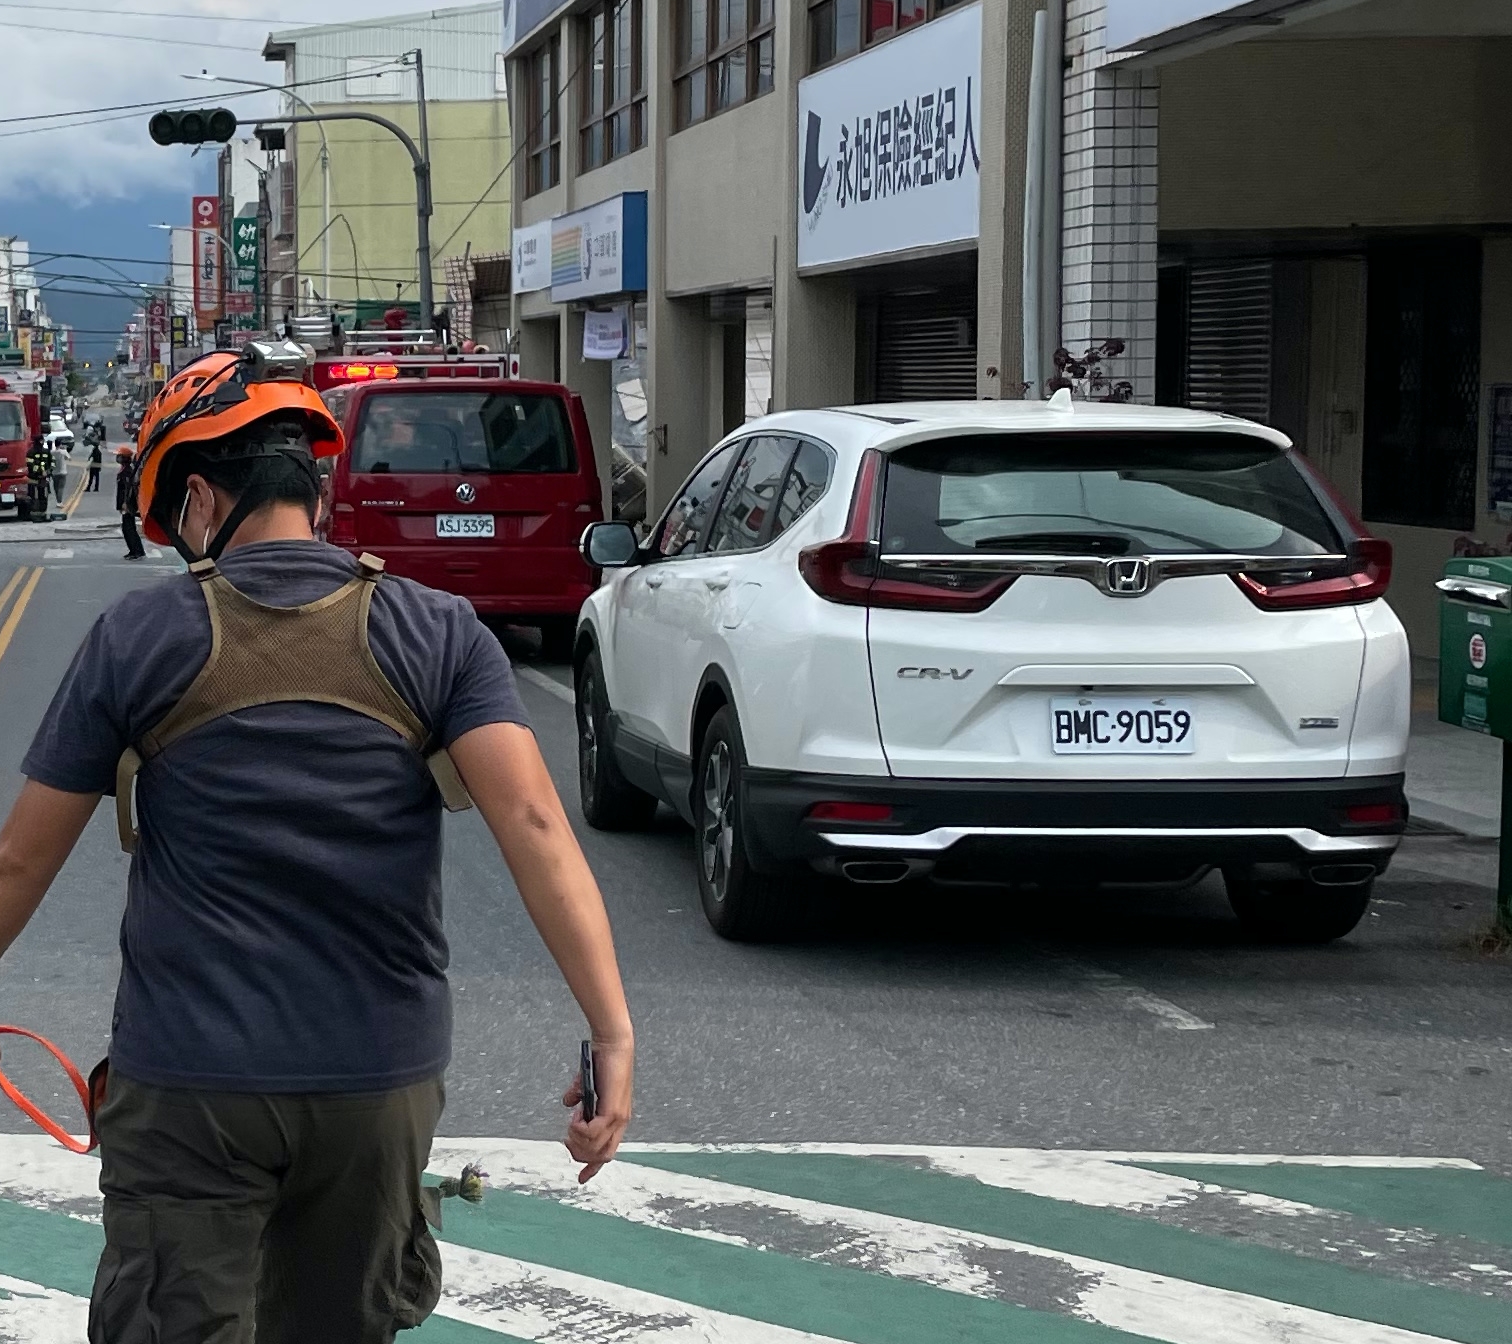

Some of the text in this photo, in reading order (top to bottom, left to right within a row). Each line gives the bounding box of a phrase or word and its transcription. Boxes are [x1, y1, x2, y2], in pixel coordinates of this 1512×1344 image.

[836, 75, 980, 209] 永旭保險經紀人
[896, 666, 974, 681] CR-V
